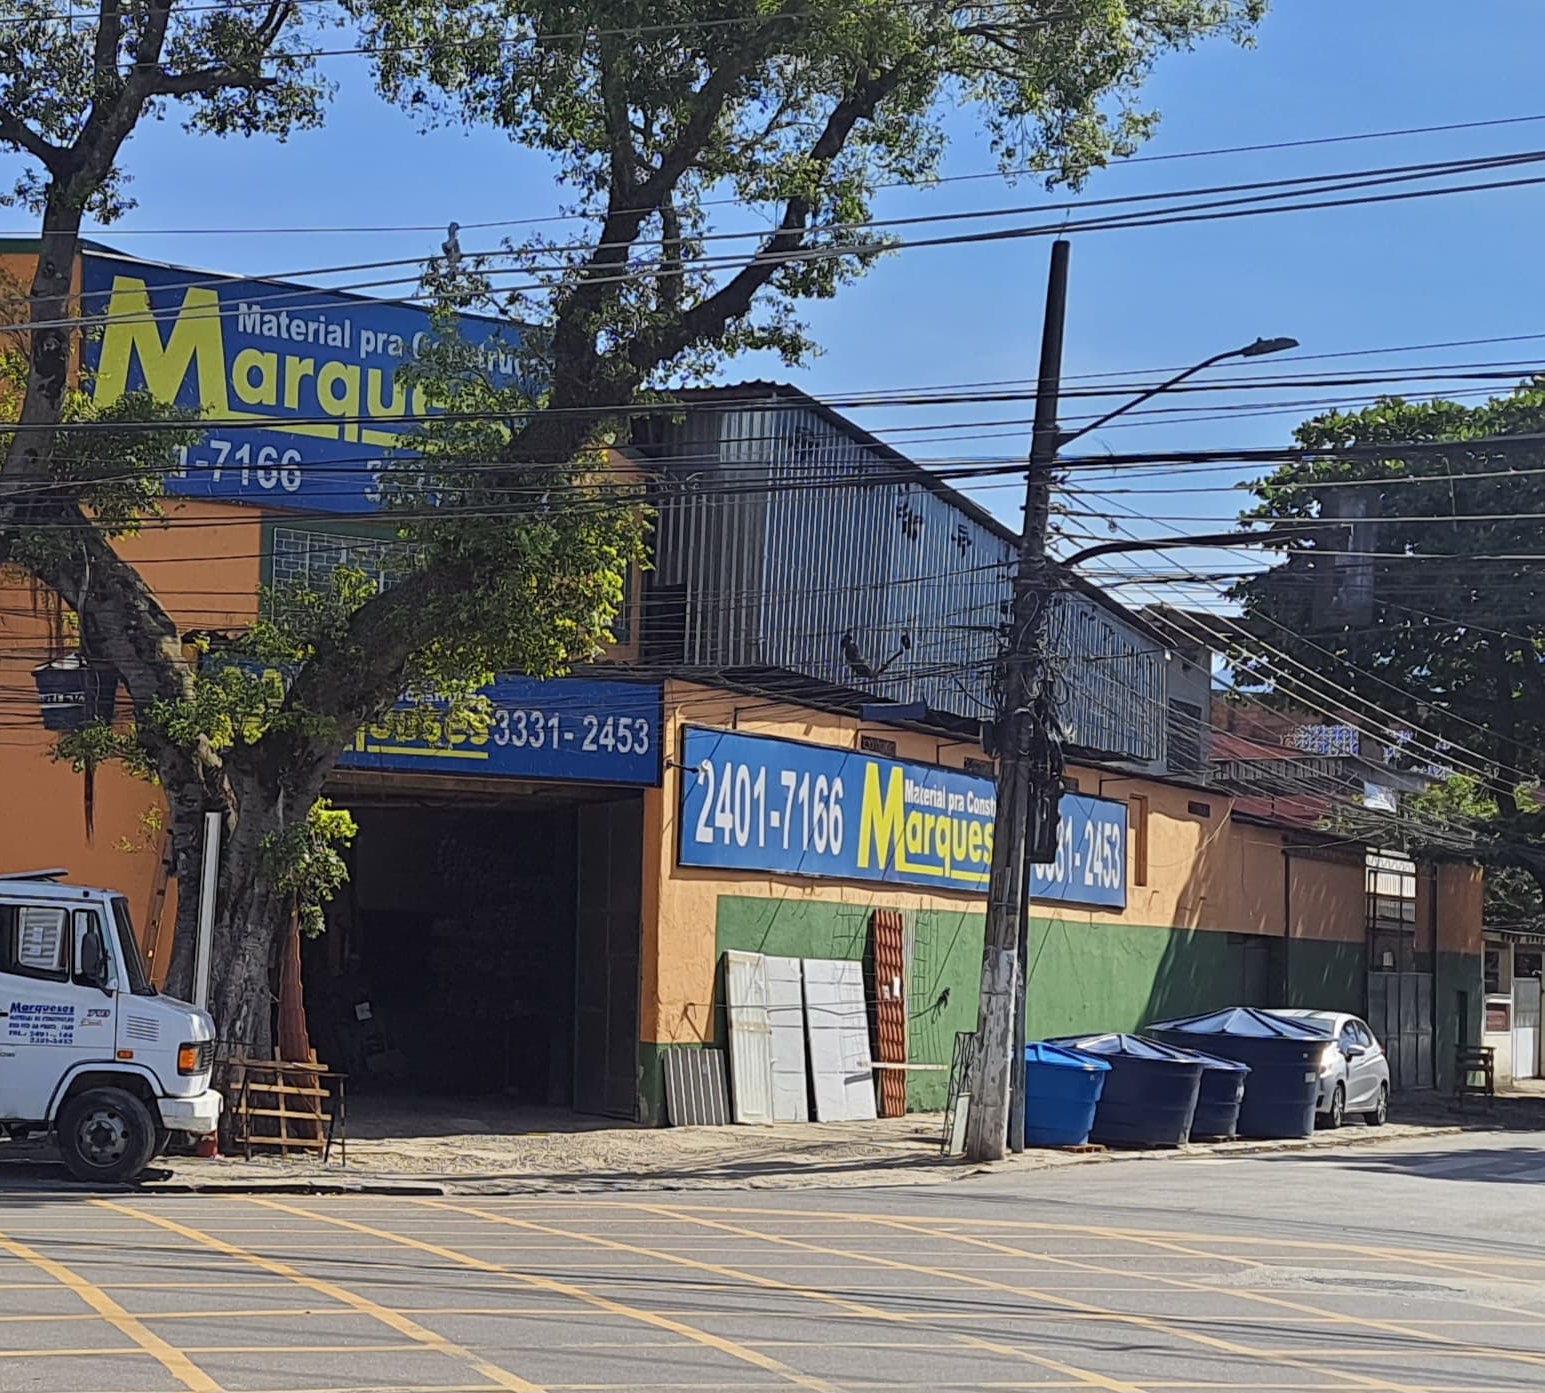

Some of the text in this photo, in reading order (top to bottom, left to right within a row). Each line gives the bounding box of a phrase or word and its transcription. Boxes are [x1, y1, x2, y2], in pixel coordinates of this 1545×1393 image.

[238, 302, 351, 348] Material
[360, 327, 403, 360] pra
[172, 440, 303, 492] 1-7166
[695, 760, 846, 857] 2401-7166
[857, 761, 996, 878] Marques
[905, 778, 946, 809] Material
[948, 791, 965, 815] pra
